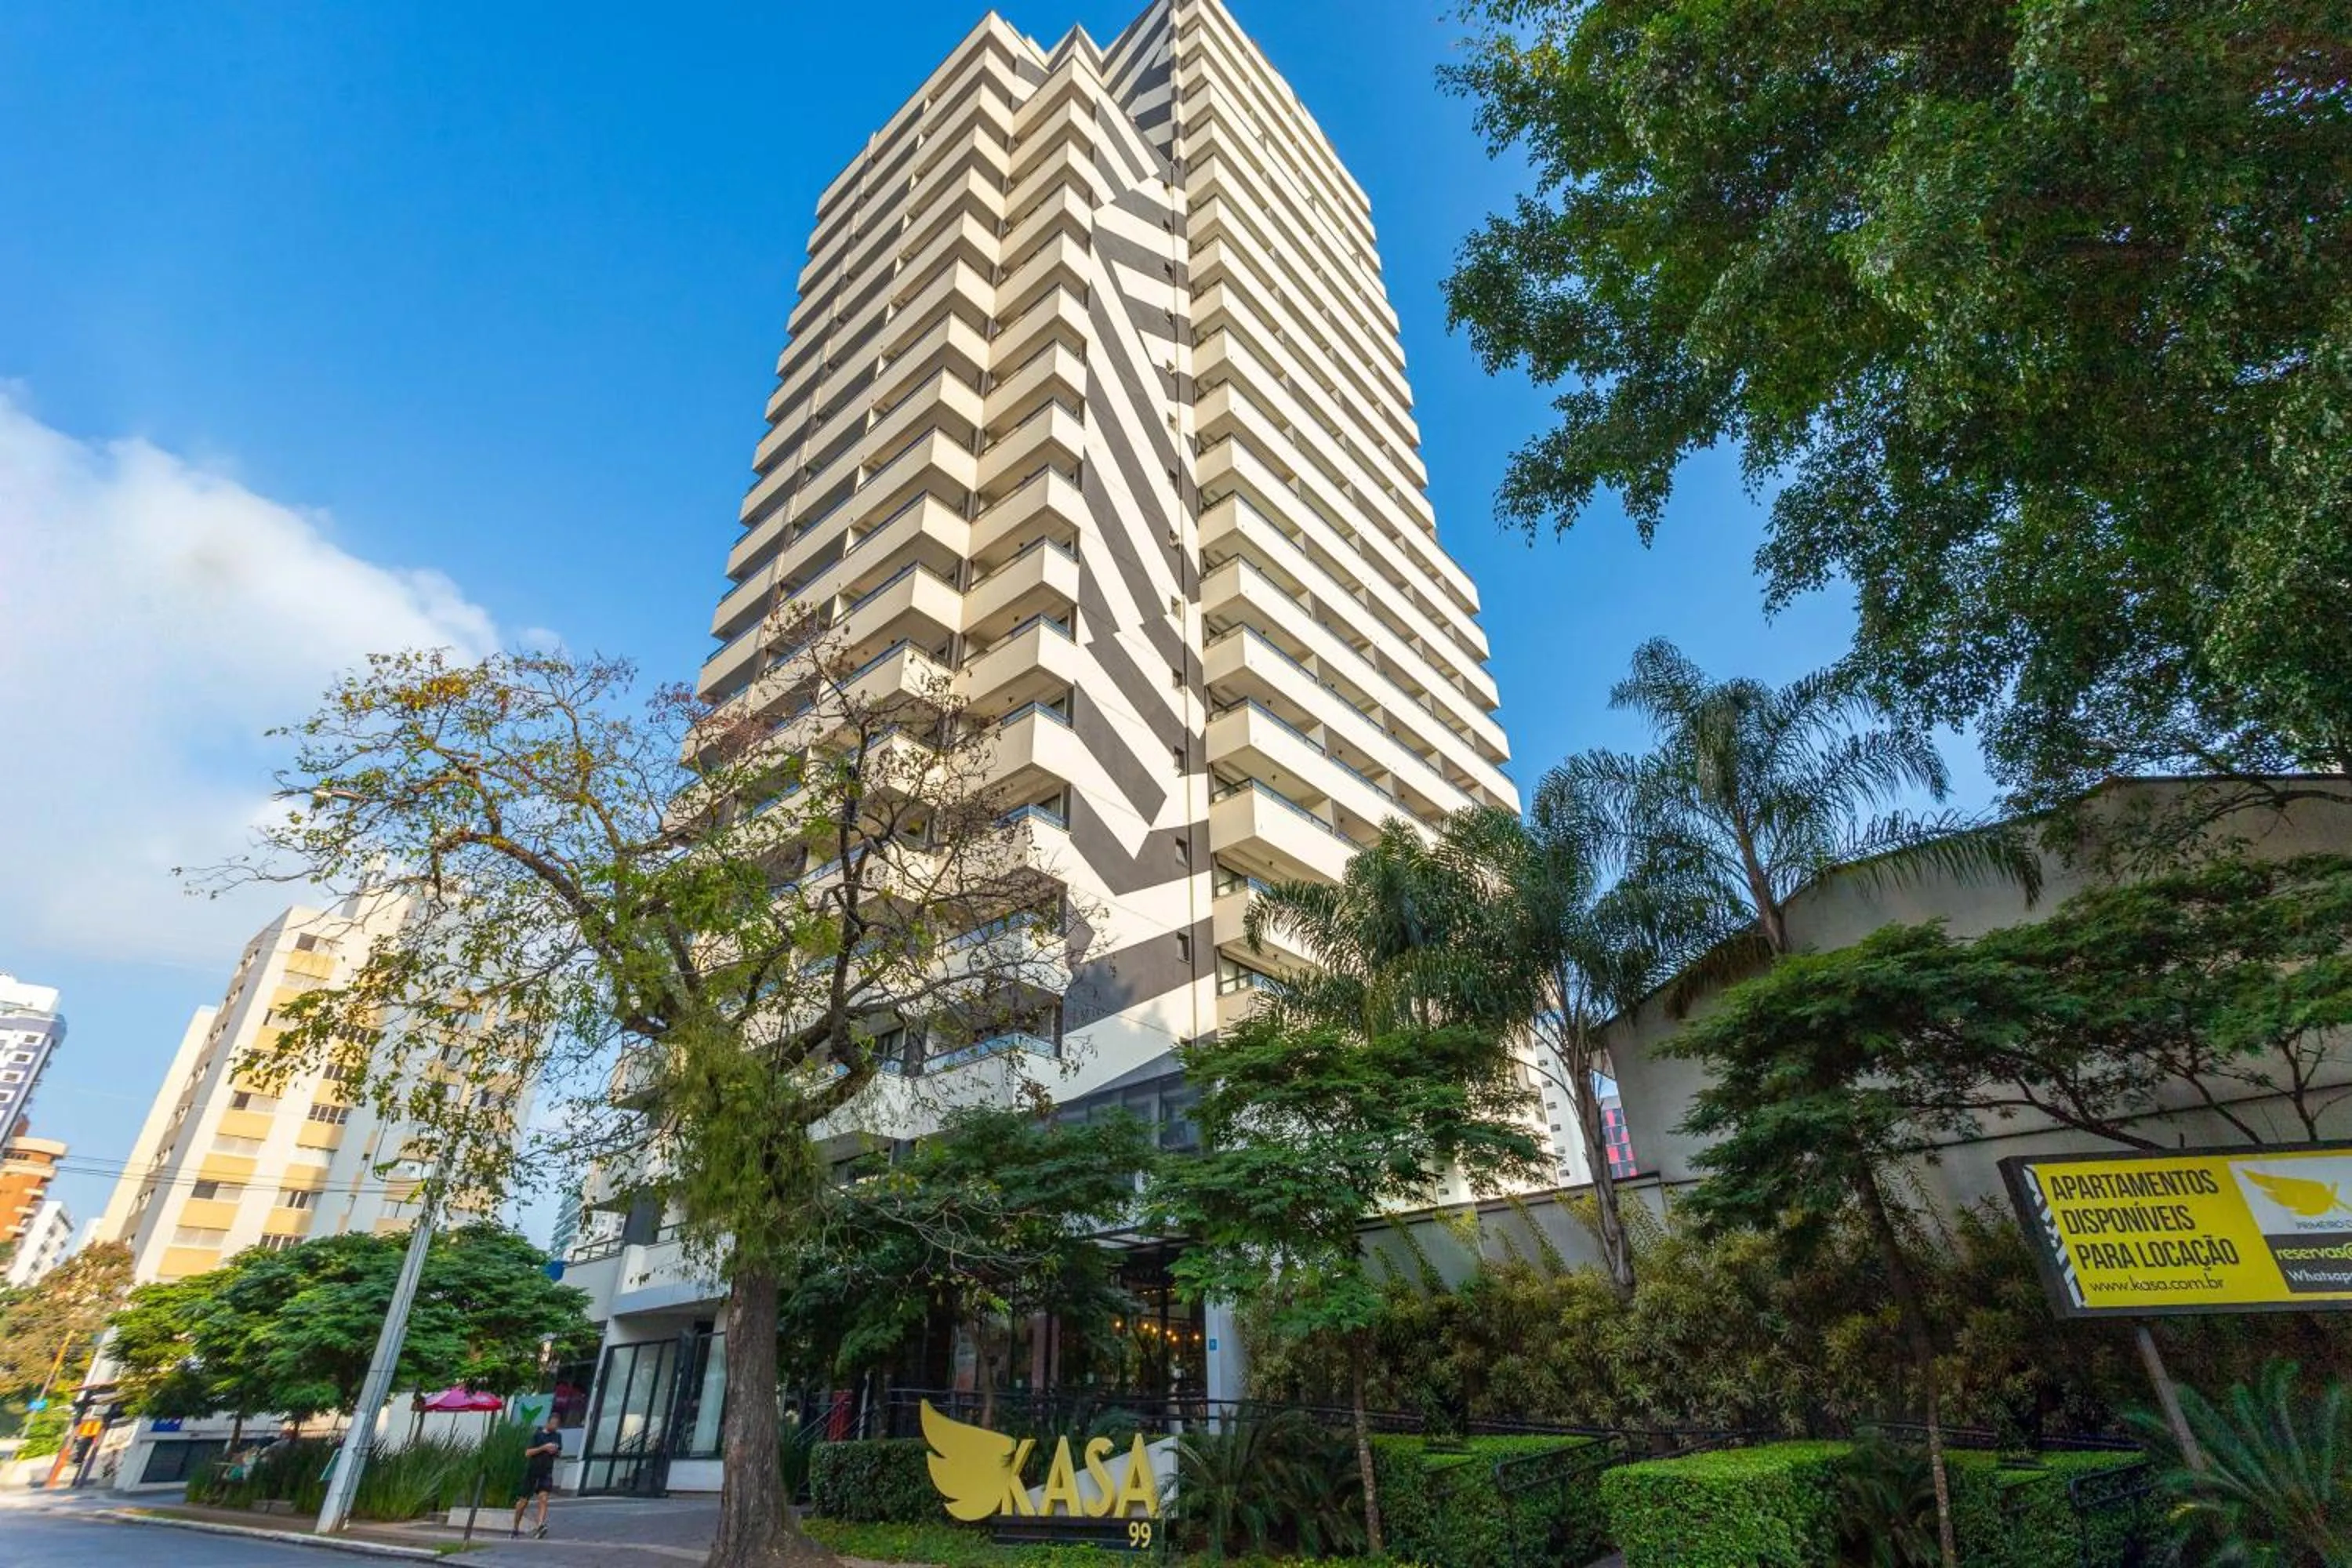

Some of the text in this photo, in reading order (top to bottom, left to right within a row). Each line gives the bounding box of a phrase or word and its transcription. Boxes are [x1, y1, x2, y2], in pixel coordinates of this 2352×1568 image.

[2049, 1169, 2220, 1201] APARTAMENTOS
[2060, 1201, 2196, 1235] DISPONÍVEIS
[2074, 1235, 2241, 1271] PARA LOCAÇÃO
[2089, 1272, 2225, 1292] www.kasa.com.br
[1000, 1432, 1160, 1519] KASA
[1128, 1521, 1152, 1548] 99
